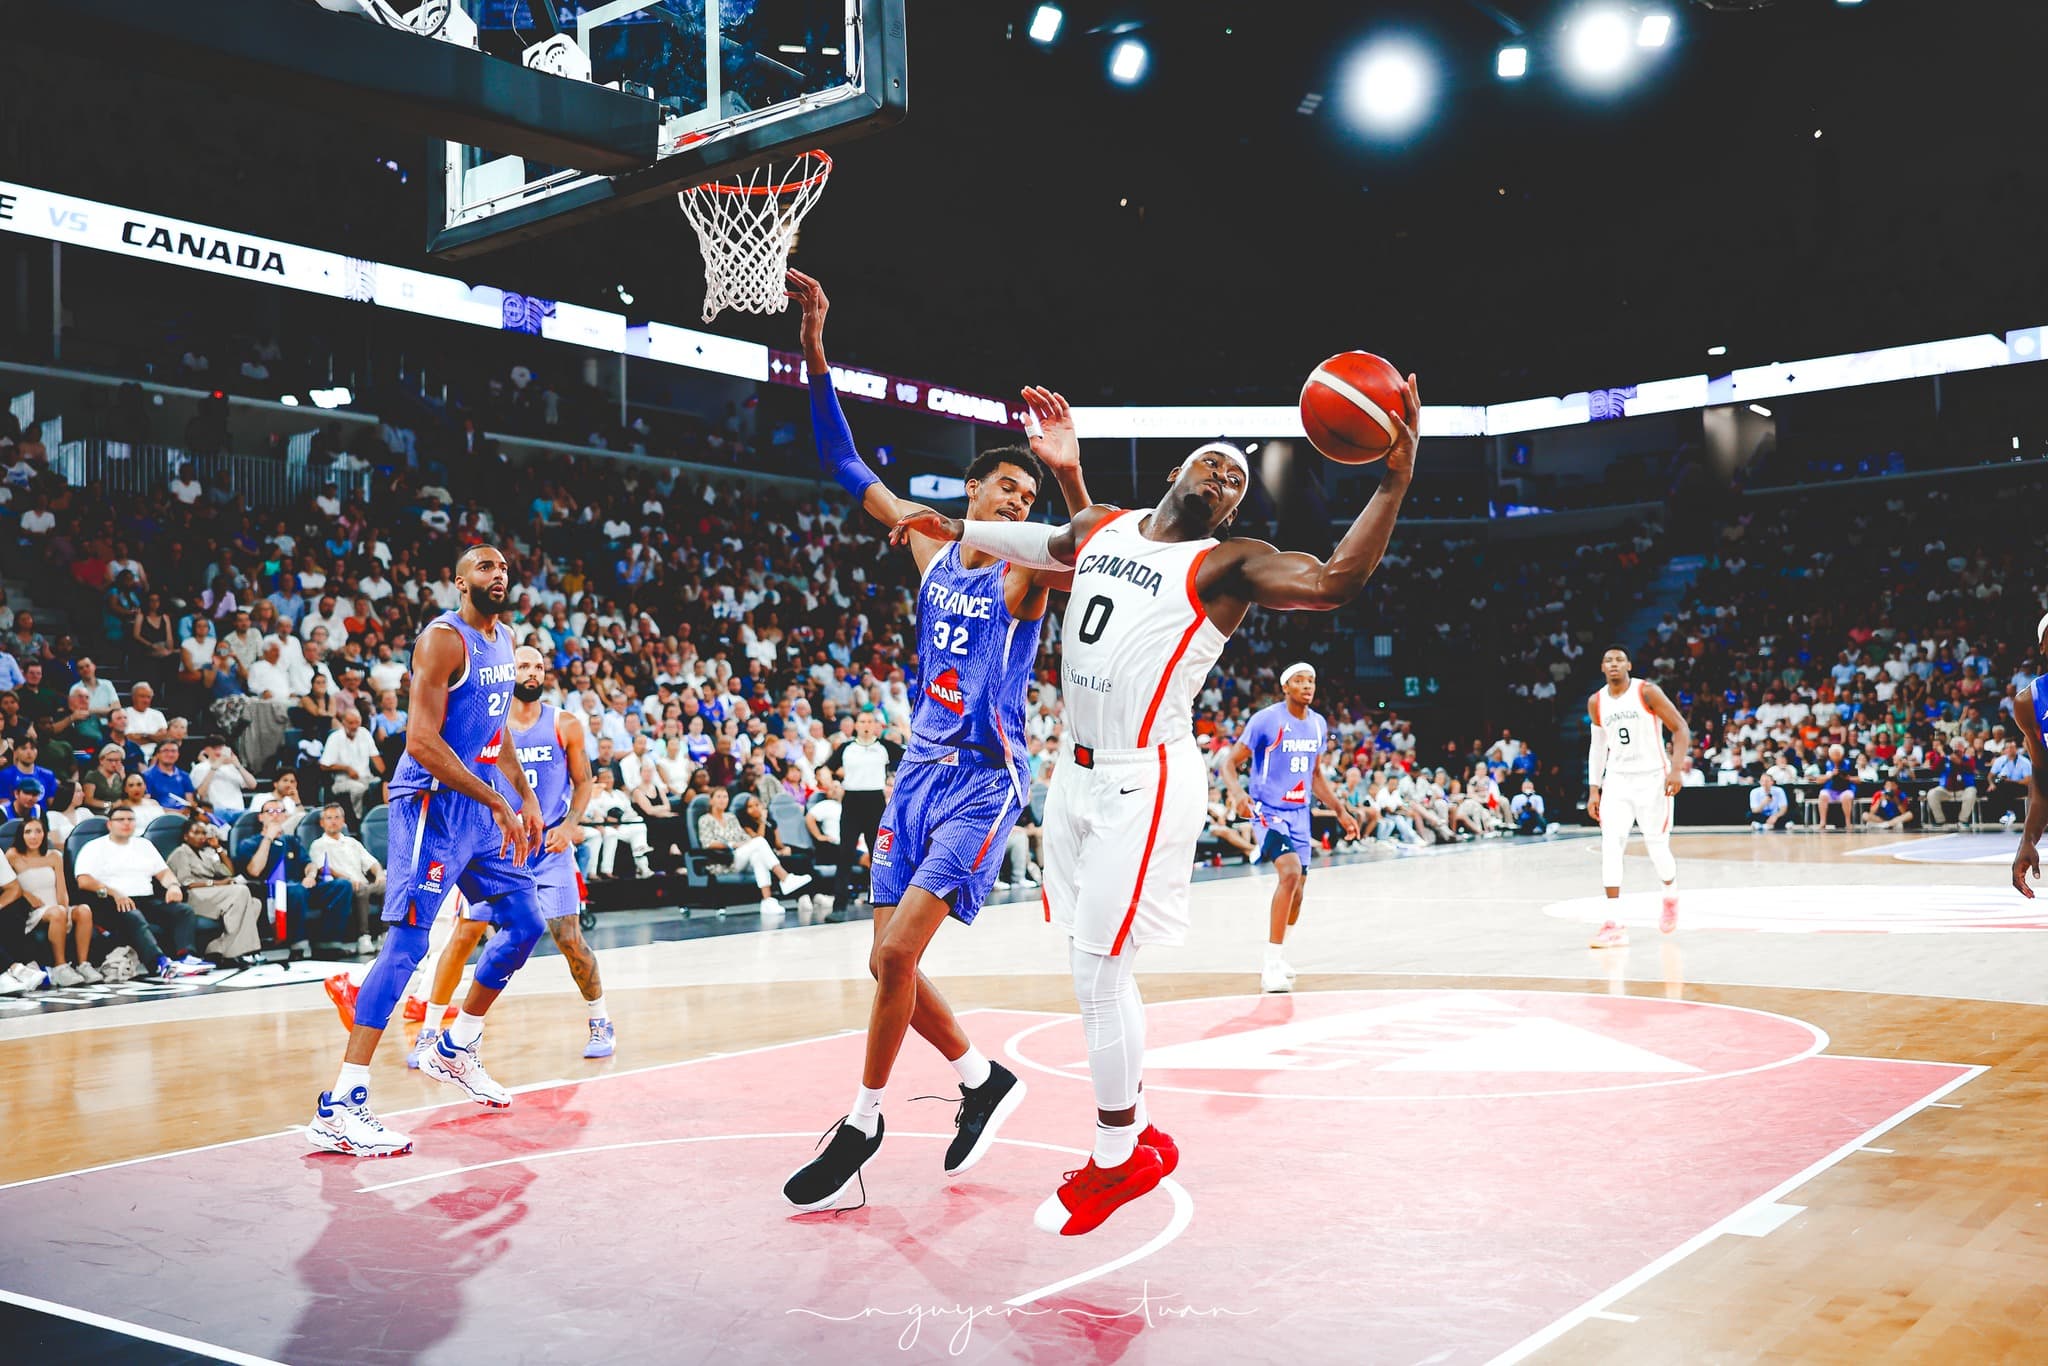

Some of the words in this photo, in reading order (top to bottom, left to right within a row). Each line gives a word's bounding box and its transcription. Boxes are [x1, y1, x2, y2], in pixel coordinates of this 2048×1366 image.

[48, 206, 88, 233] VS
[122, 221, 286, 275] CANADA
[927, 387, 1009, 425] CANADA
[1078, 555, 1163, 597] CANADA
[927, 581, 993, 620] FRANCE
[1078, 594, 1115, 645] 0
[933, 620, 969, 656] 32
[479, 663, 516, 687] FRANCE
[1070, 667, 1088, 688] Sun
[1090, 675, 1113, 693] Life
[487, 691, 510, 717] 27
[929, 680, 963, 704] MAIF
[1283, 739, 1317, 752] FRANCE
[1619, 728, 1631, 744] 9
[516, 745, 553, 764] ANCE
